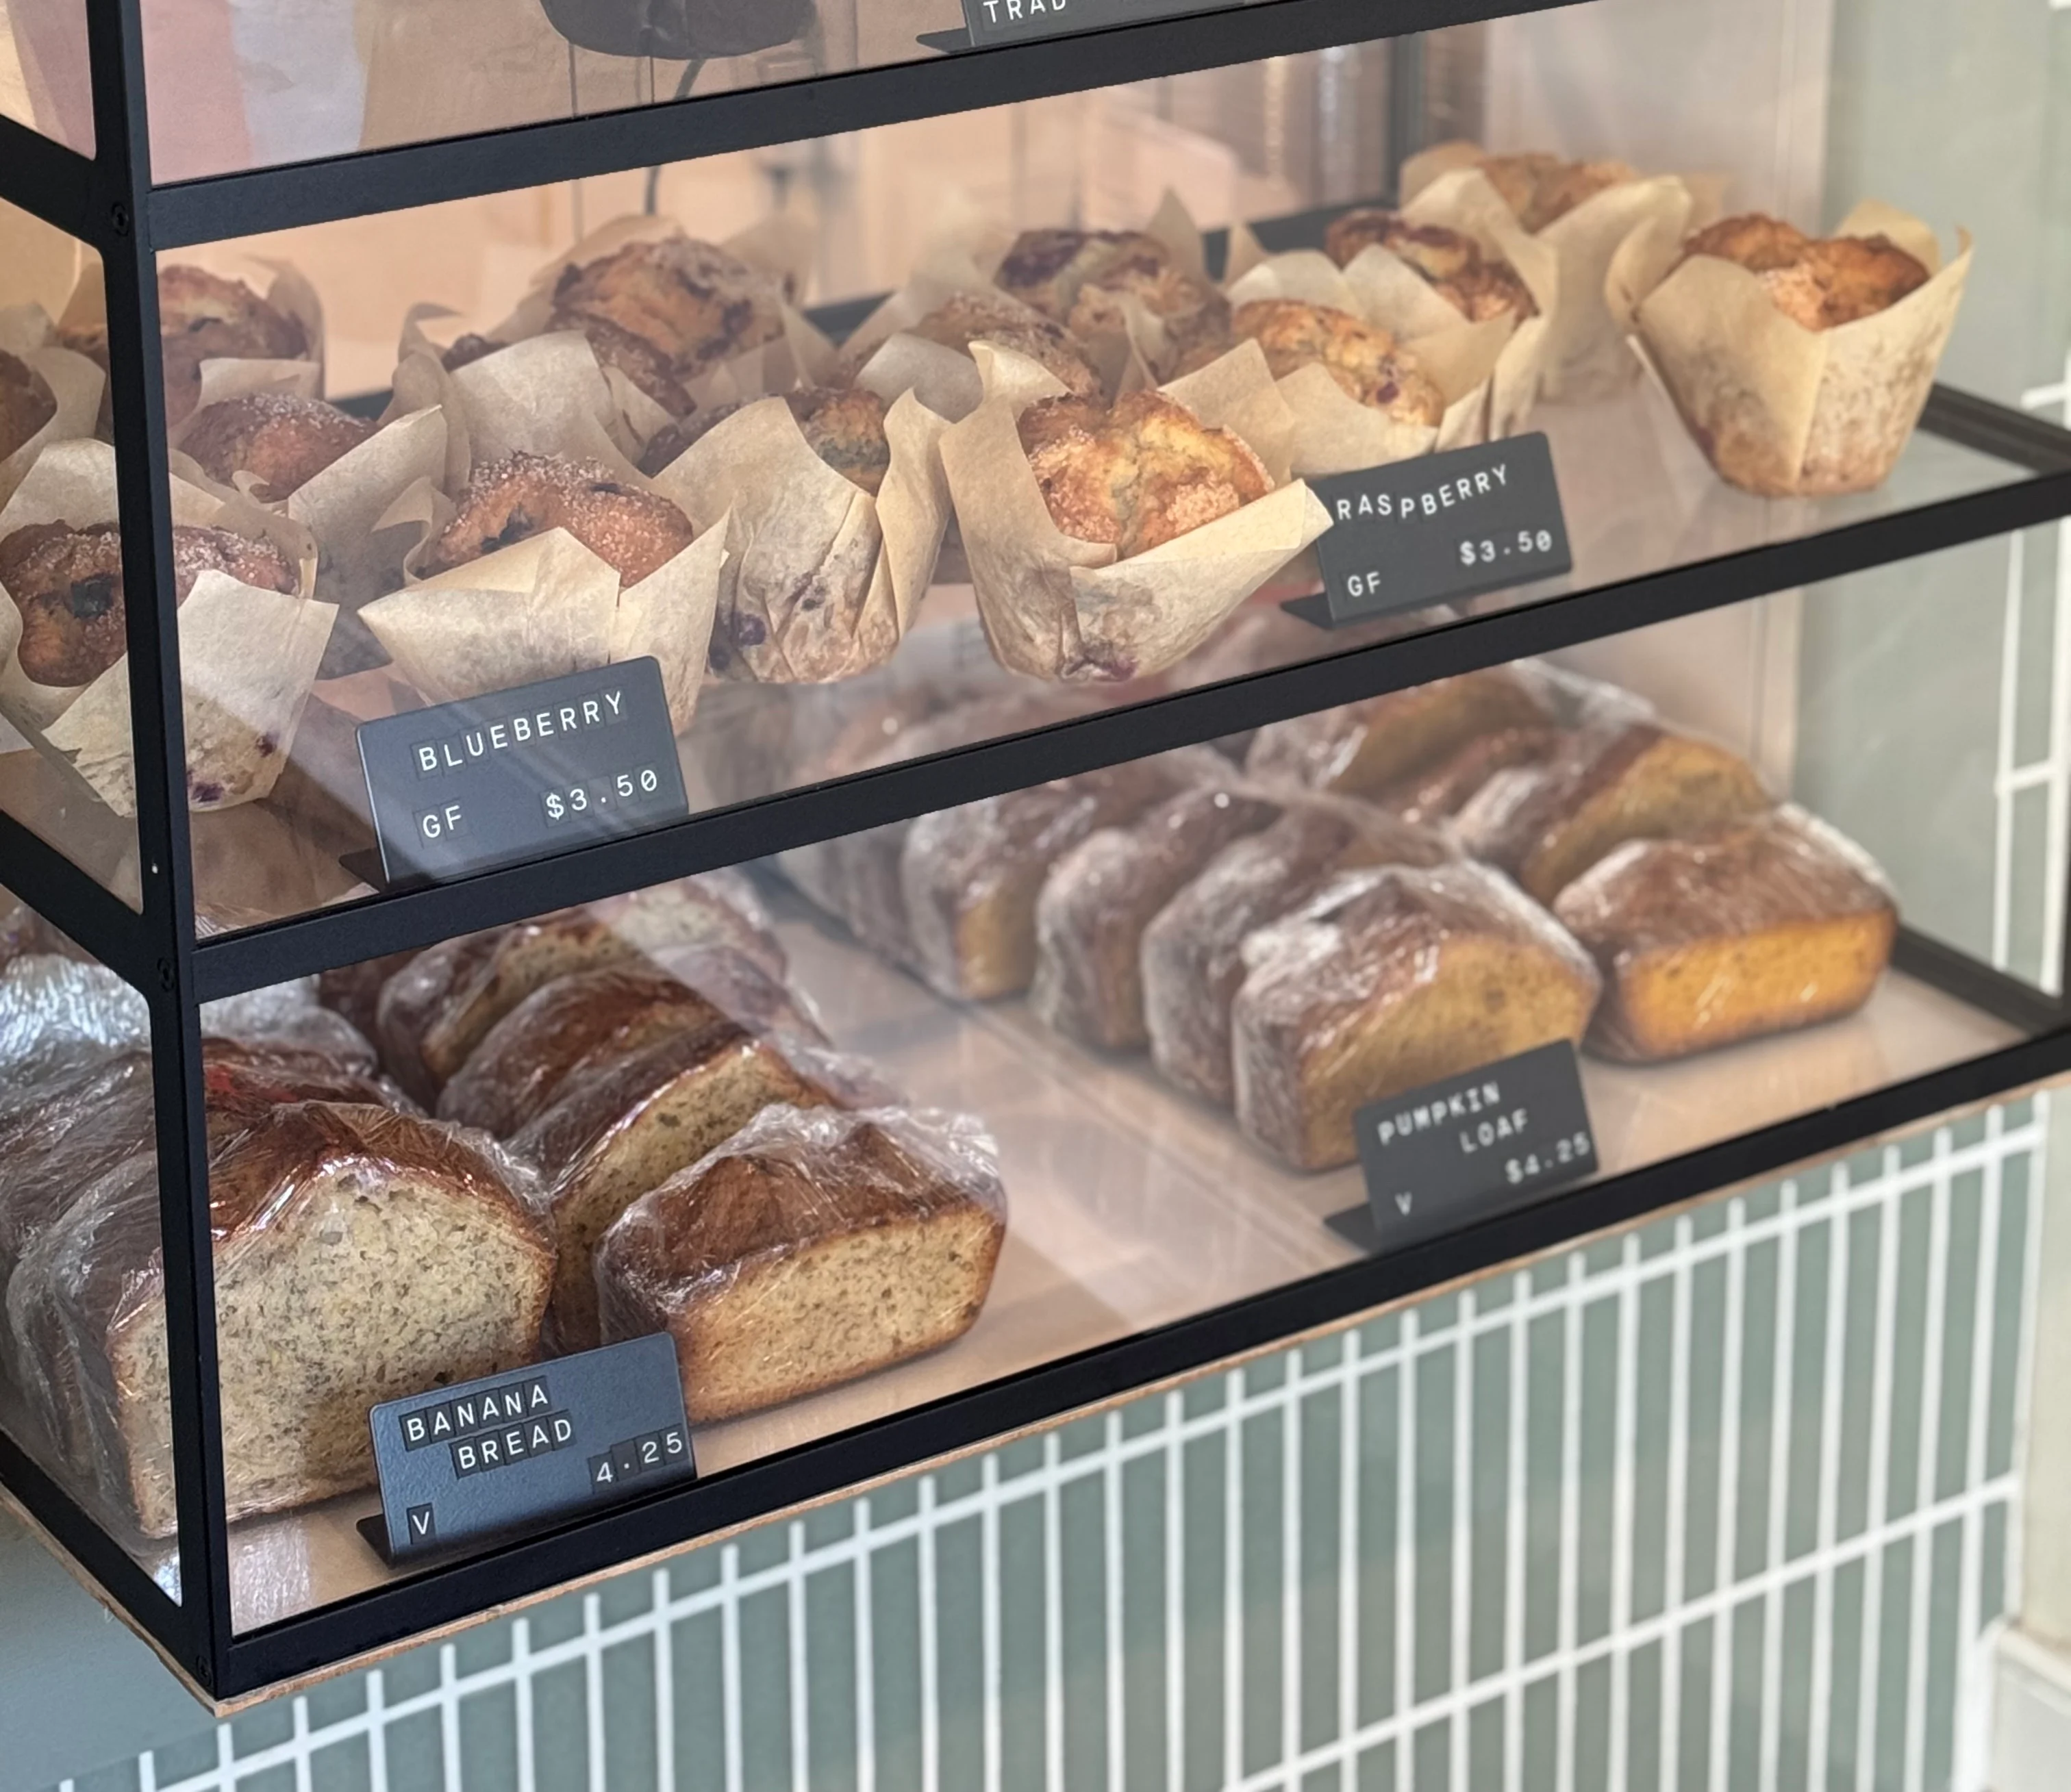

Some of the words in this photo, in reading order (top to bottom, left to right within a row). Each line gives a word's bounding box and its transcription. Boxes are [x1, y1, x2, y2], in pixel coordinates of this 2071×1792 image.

[1335, 464, 1506, 520] RASPBERRY
[1459, 529, 1553, 566] $3.50
[1346, 571, 1381, 597] GF
[418, 691, 621, 772] BLUEBERRY
[546, 770, 658, 820] $3.50
[422, 805, 462, 839] GF
[1377, 1081, 1501, 1146] PUMPKIN
[1459, 1108, 1528, 1154] LOAF
[1505, 1131, 1591, 1185] $4.25
[1395, 1191, 1413, 1216] V
[407, 1385, 548, 1442] BANANA
[458, 1418, 572, 1469] BREAD
[596, 1432, 683, 1483] 4.25
[412, 1511, 430, 1535] V
